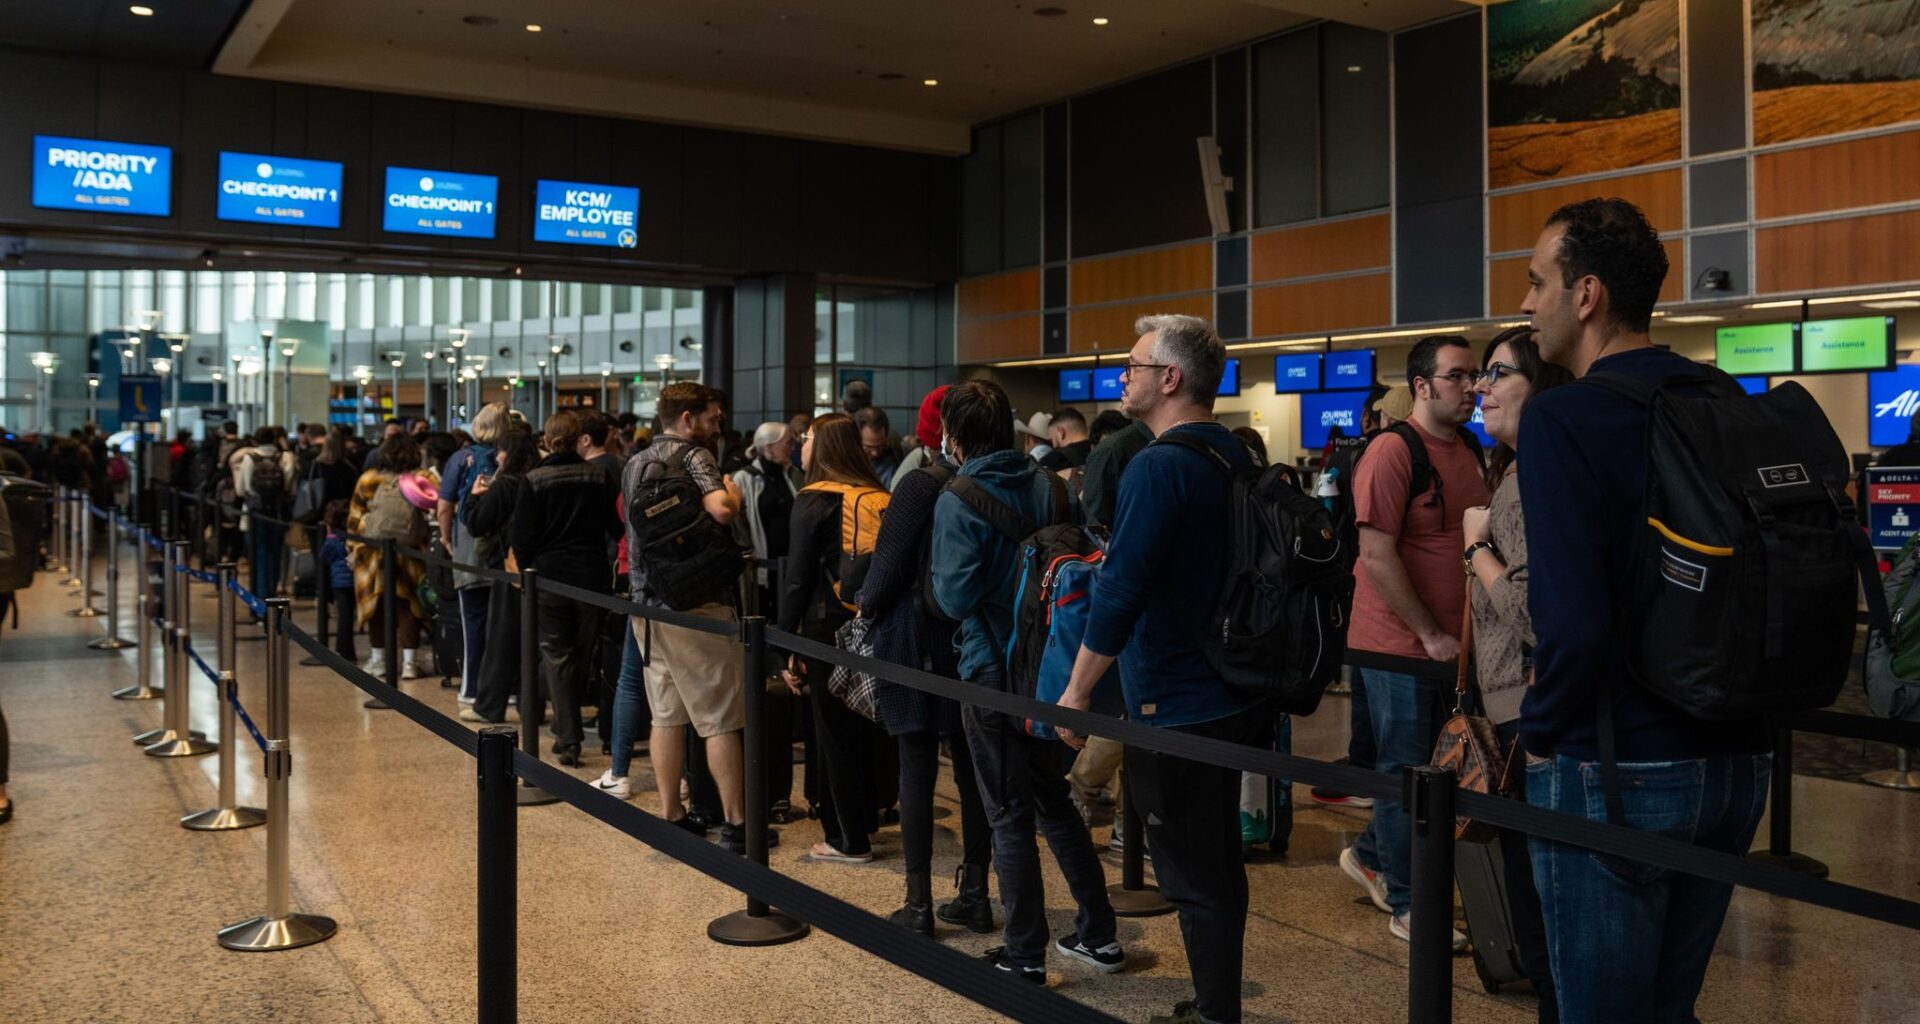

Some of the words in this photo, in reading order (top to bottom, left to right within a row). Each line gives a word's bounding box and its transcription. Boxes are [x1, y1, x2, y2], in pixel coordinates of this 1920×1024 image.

[49, 148, 157, 174] PRIORITY
[73, 169, 132, 192] /ADA
[223, 180, 327, 201] CHECKPOINT
[329, 189, 337, 202] 1
[389, 194, 483, 213] CHECKPOINT
[485, 202, 493, 214] 1
[566, 189, 612, 208] KCM/
[540, 204, 634, 226] EMPLOYEE
[1321, 410, 1353, 419] JOURNEY
